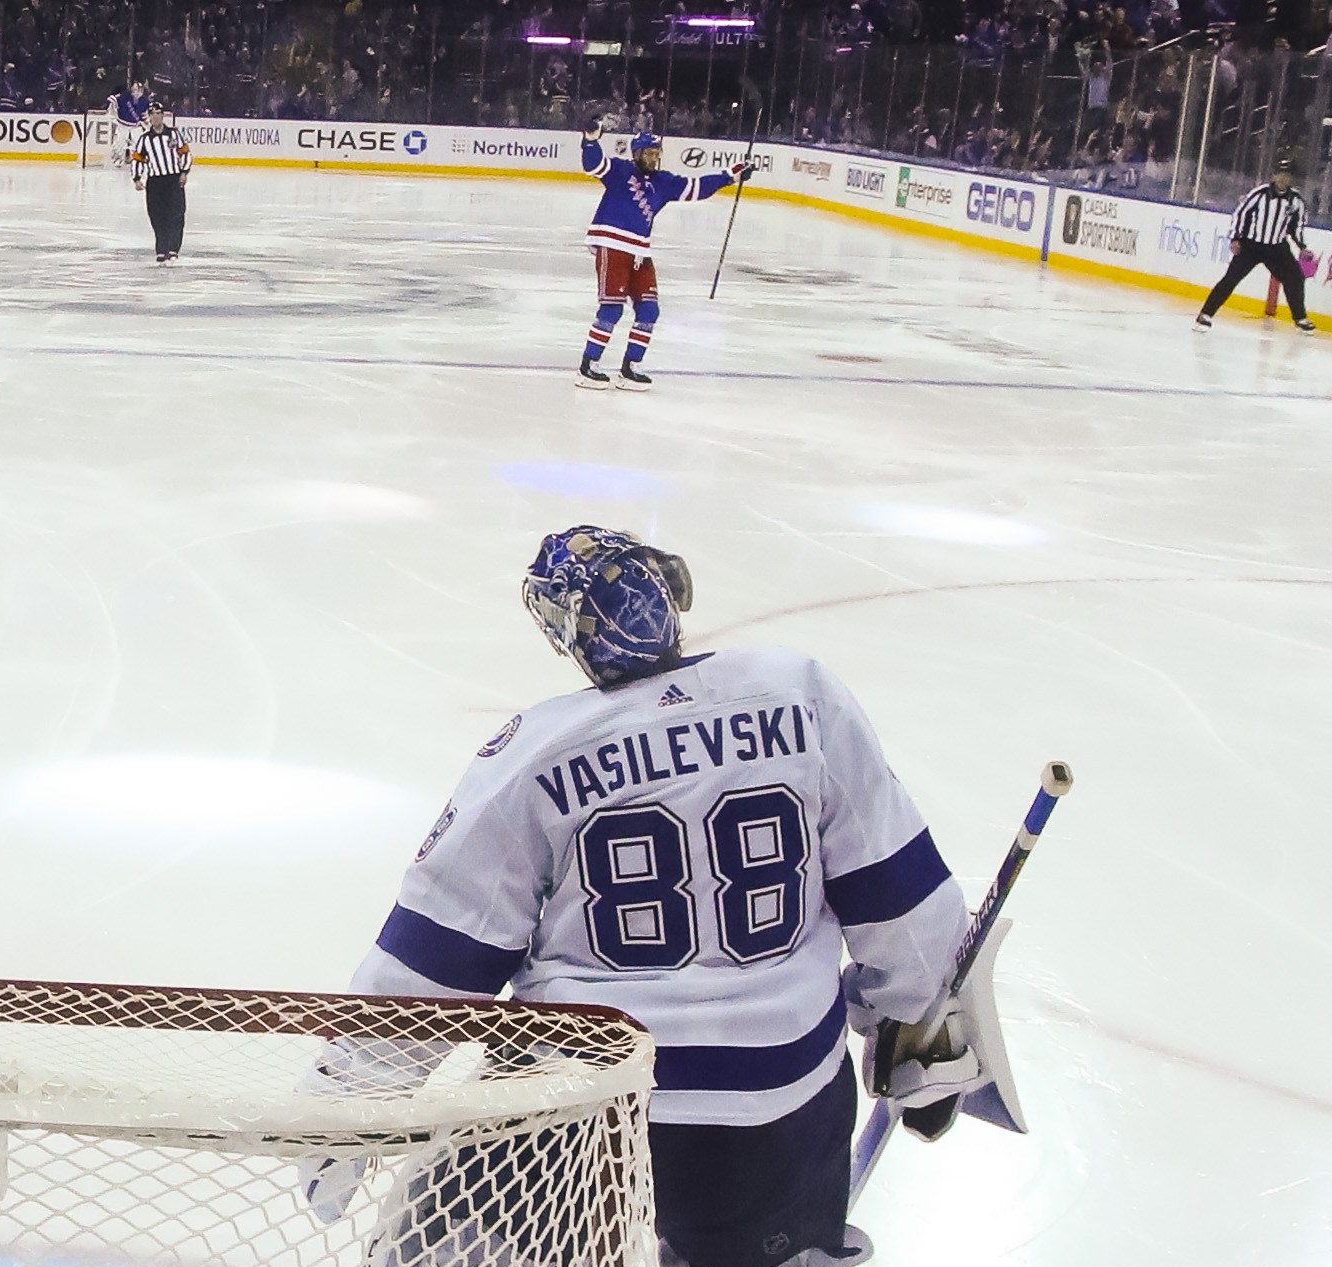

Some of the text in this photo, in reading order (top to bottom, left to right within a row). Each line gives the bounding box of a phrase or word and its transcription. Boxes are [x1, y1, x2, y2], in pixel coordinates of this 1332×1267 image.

[180, 126, 281, 147] MSTERDAM VODKA
[298, 129, 397, 152] CHASE
[473, 138, 560, 159] Northwell
[712, 151, 774, 172] HYUDAI
[847, 167, 885, 193] BUD LIGHT
[898, 178, 952, 206] enterprise
[967, 182, 1035, 232] GEICO
[1084, 198, 1118, 219] CAESARS
[1079, 220, 1139, 256] SPORTSBOOK
[1158, 217, 1200, 262] Infosys
[535, 704, 815, 816] VASILEVSKI
[575, 782, 811, 972] 88
